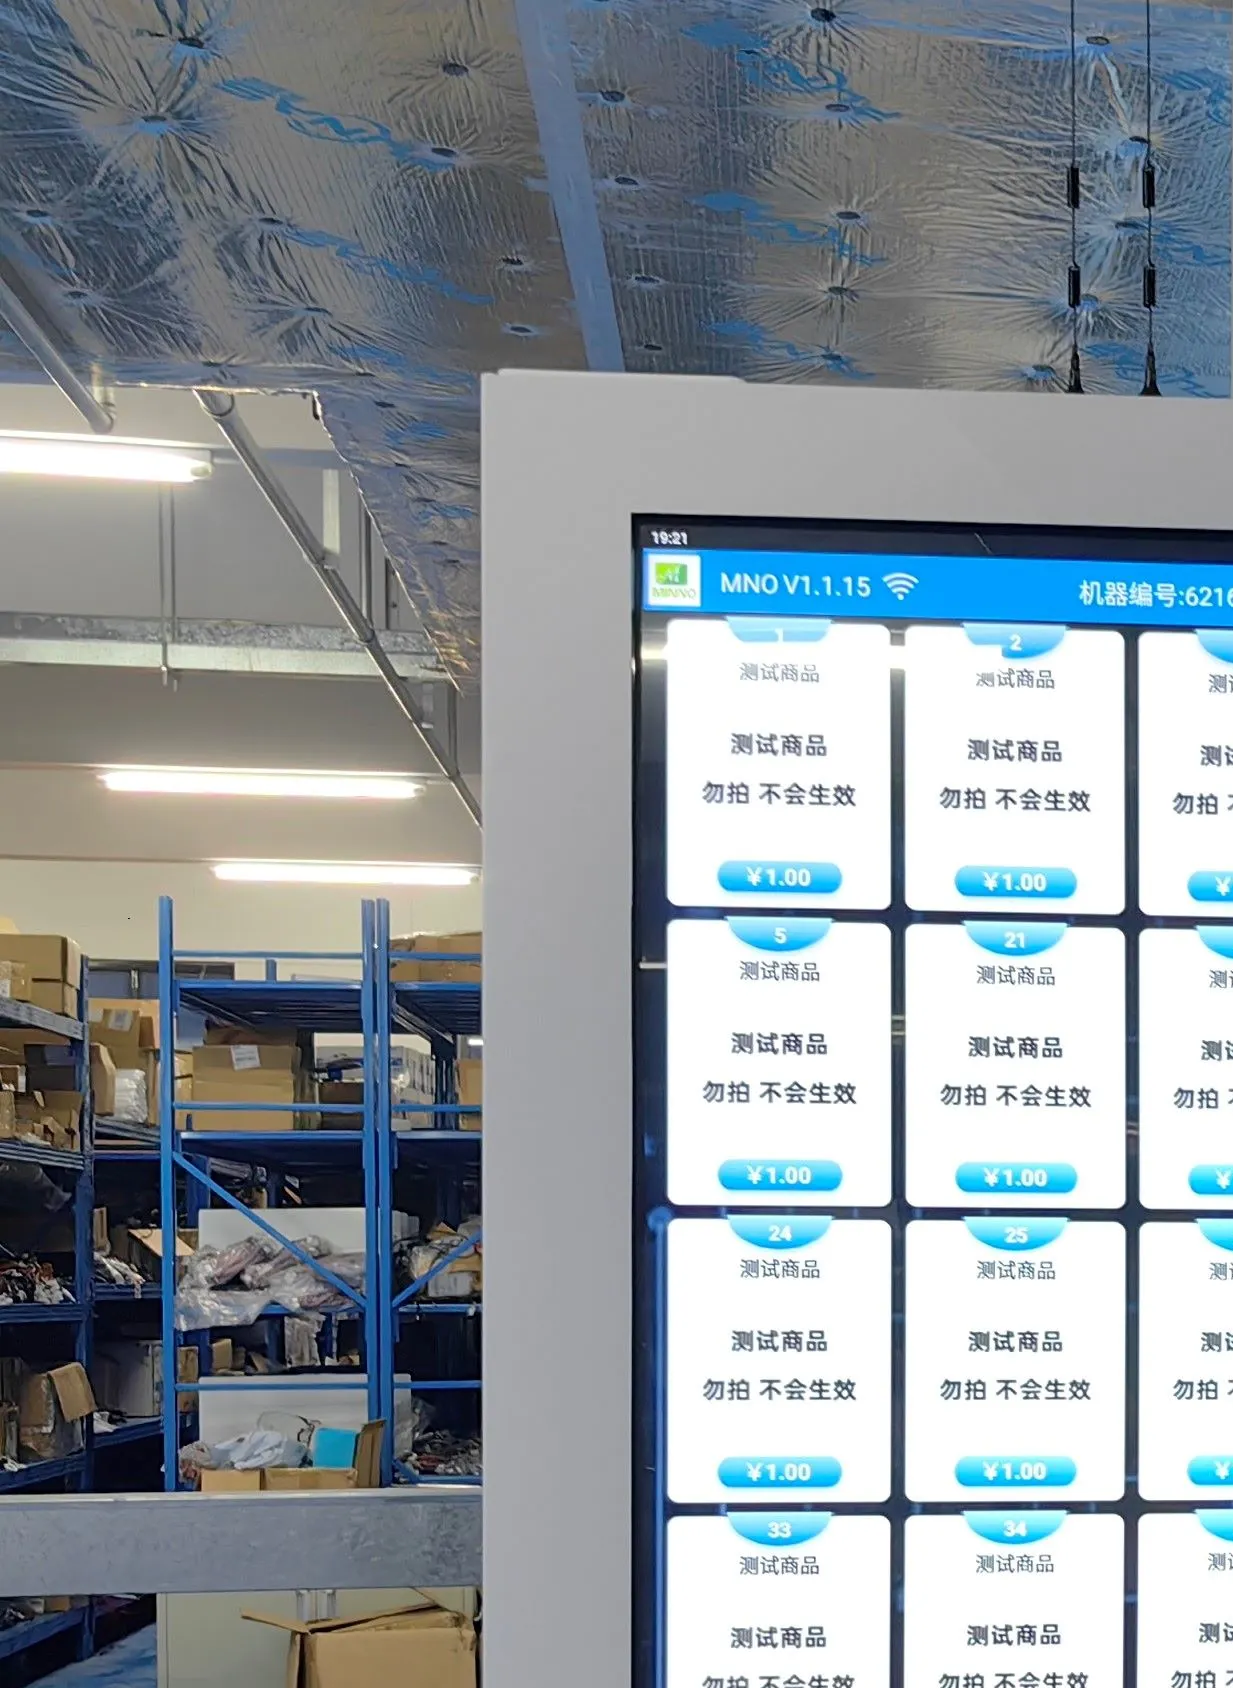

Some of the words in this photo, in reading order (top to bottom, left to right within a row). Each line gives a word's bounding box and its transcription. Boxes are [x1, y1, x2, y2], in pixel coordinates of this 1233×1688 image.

[651, 531, 688, 545] 19:21
[720, 572, 779, 595] MNO
[782, 574, 872, 598] V1.1.15
[1010, 634, 1022, 651] 2
[732, 734, 826, 756] 测试商品
[968, 739, 1062, 762] 测试商品
[703, 782, 749, 803] 勿拍
[759, 783, 856, 806] 不会生效
[940, 787, 985, 809] 勿拍
[996, 789, 1090, 812] 不会生效
[1173, 793, 1218, 815] 勿拍
[774, 927, 786, 945] 5
[1003, 932, 1025, 949] 21
[739, 960, 820, 982] 测试商品
[976, 965, 1056, 986] 测试商品
[732, 1032, 827, 1055] 测试商品
[969, 1036, 1062, 1058] 测试商品
[703, 1081, 749, 1102] 勿拍
[760, 1082, 856, 1104] 不会生效
[941, 1084, 986, 1106] 勿拍
[996, 1085, 1091, 1107] 不会生效
[1174, 1088, 1218, 1109] 勿拍
[768, 1225, 792, 1242] 24
[1006, 1227, 1028, 1244] 25
[739, 1258, 820, 1279] 测试商品
[976, 1260, 1056, 1280] 测试商品
[732, 1330, 827, 1352] 测试商品
[969, 1331, 1062, 1352] 测试商品
[703, 1379, 749, 1400] 勿拍
[760, 1379, 856, 1400] 不会生效
[941, 1379, 986, 1400] 勿拍
[996, 1379, 1090, 1400] 不会生效
[1174, 1380, 1218, 1400] 勿拍
[767, 1522, 791, 1539] 33
[1005, 1521, 1026, 1538] 34
[739, 1555, 820, 1576] 测试商品
[975, 1553, 1054, 1574] 测试商品
[731, 1627, 826, 1648] 测试商品
[967, 1624, 1060, 1646] 测试商品
